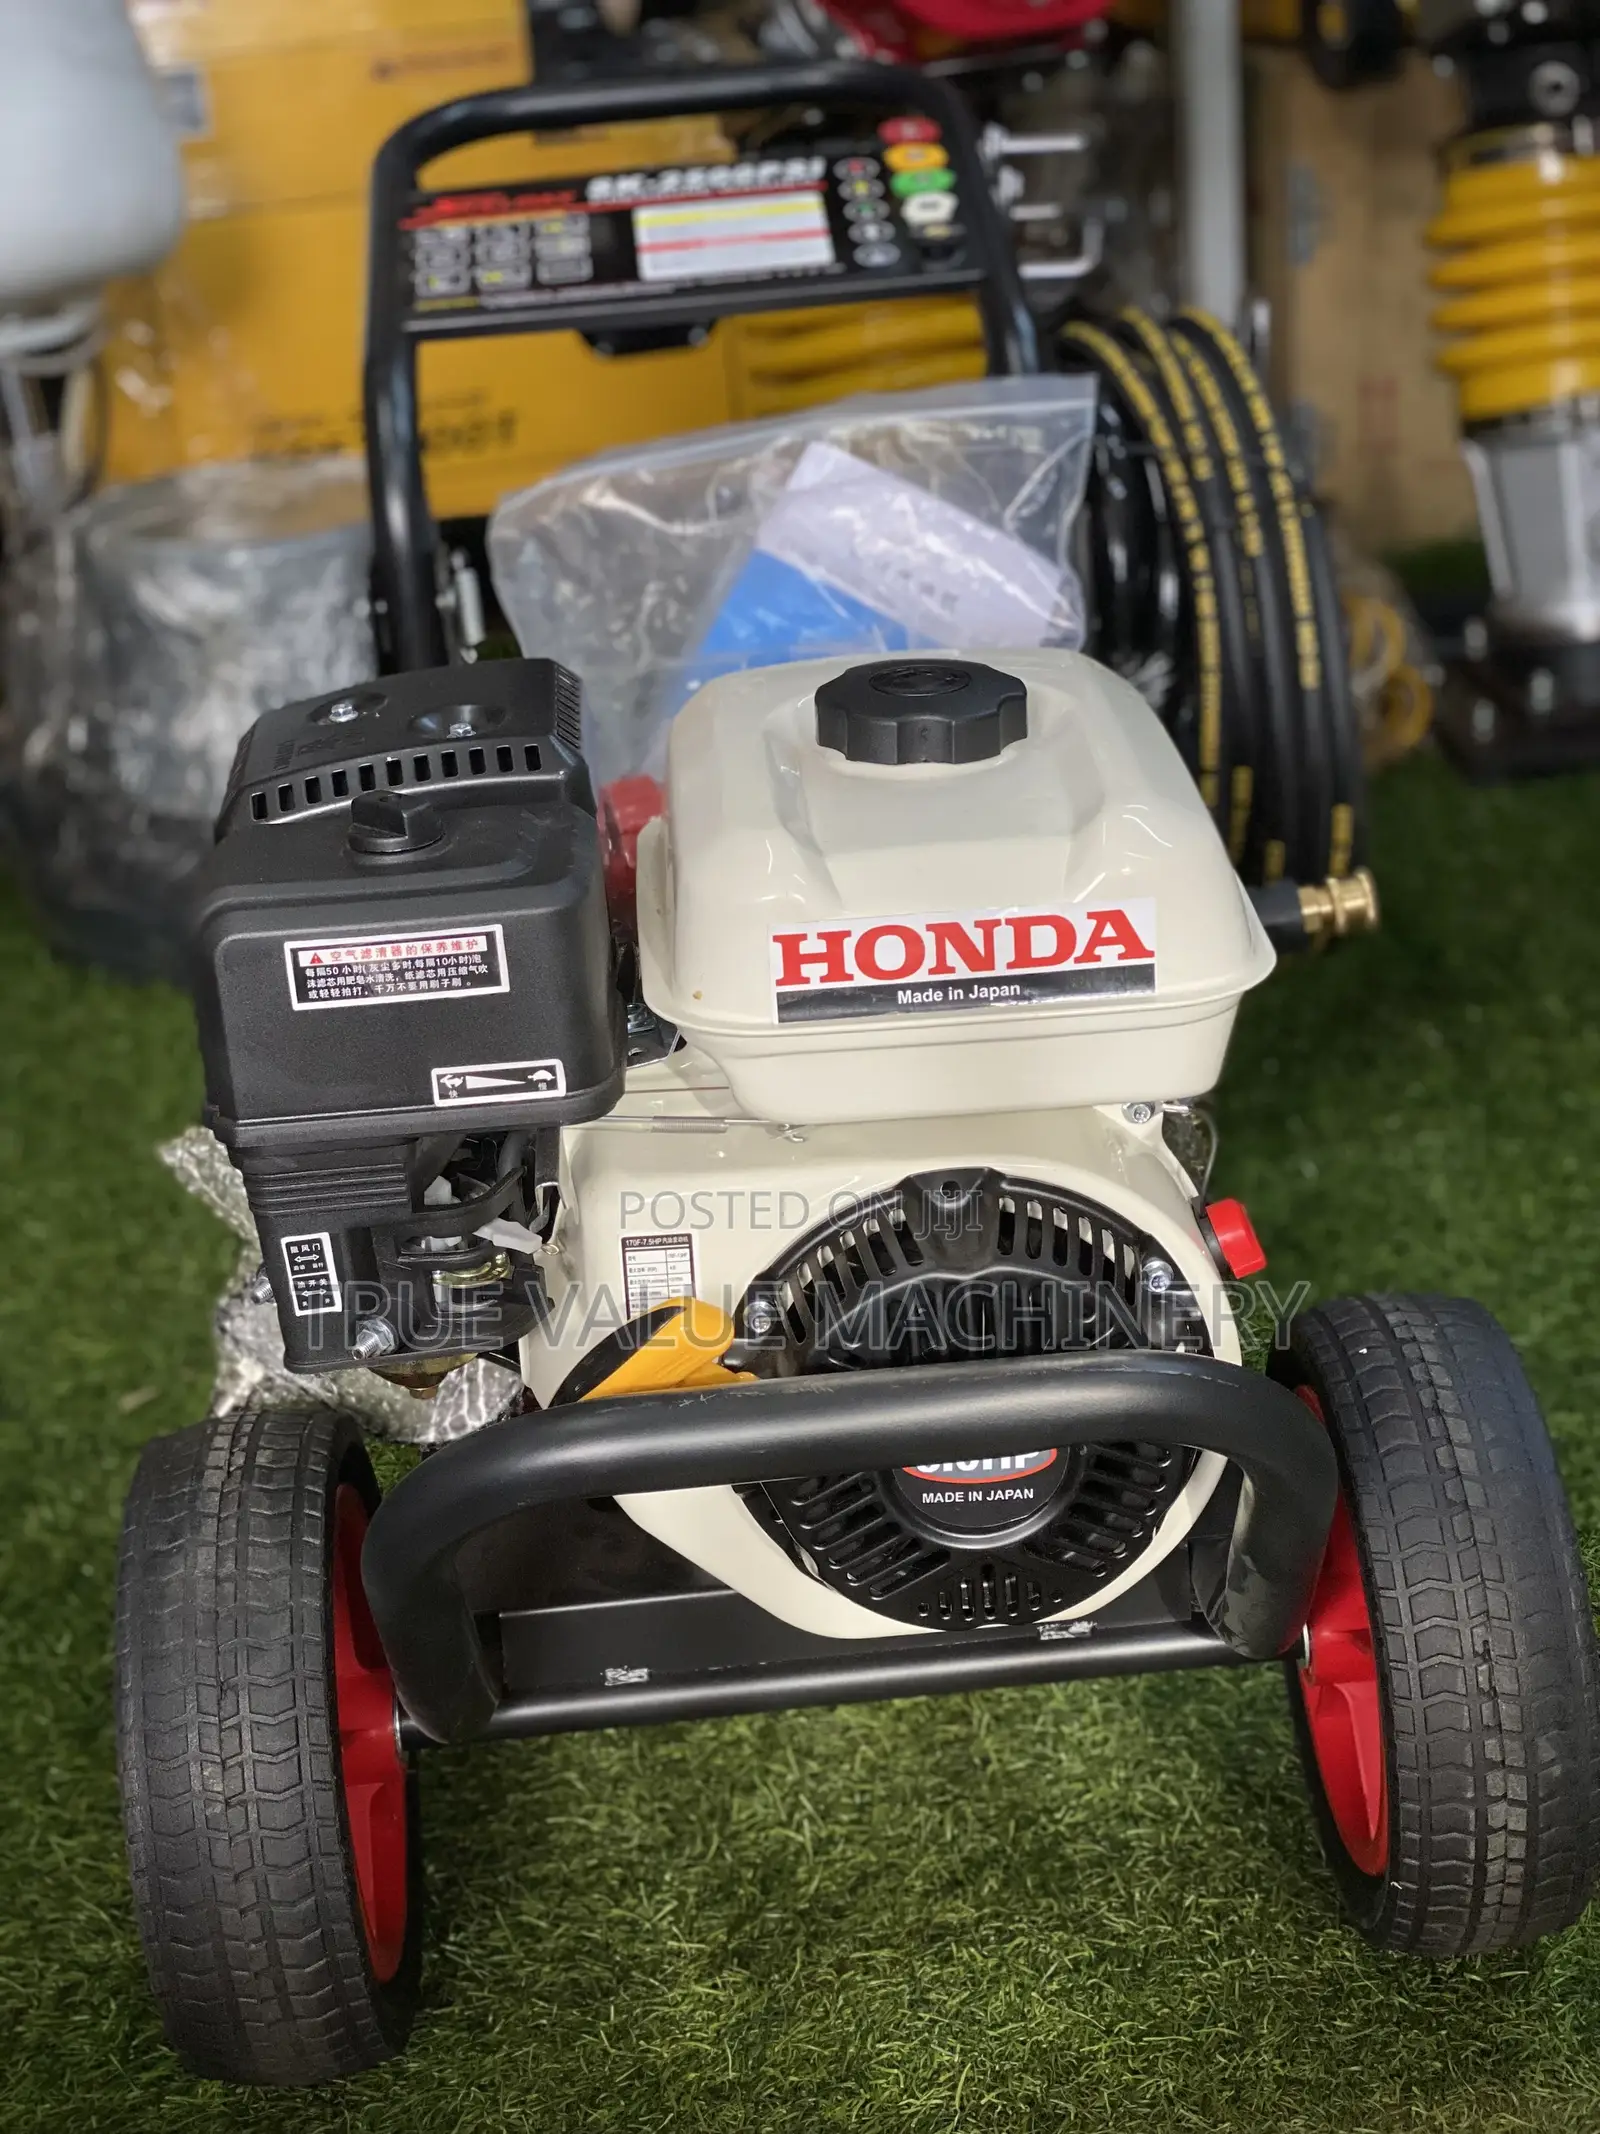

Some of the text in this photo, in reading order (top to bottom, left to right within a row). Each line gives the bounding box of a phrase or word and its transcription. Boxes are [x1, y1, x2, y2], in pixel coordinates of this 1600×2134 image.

[330, 938, 479, 962] 空气滤清器的保养维护
[772, 909, 1155, 987] HONDA
[897, 981, 1021, 1005] Made in Japan
[922, 1488, 1034, 1504] MADE IN JAPAN
